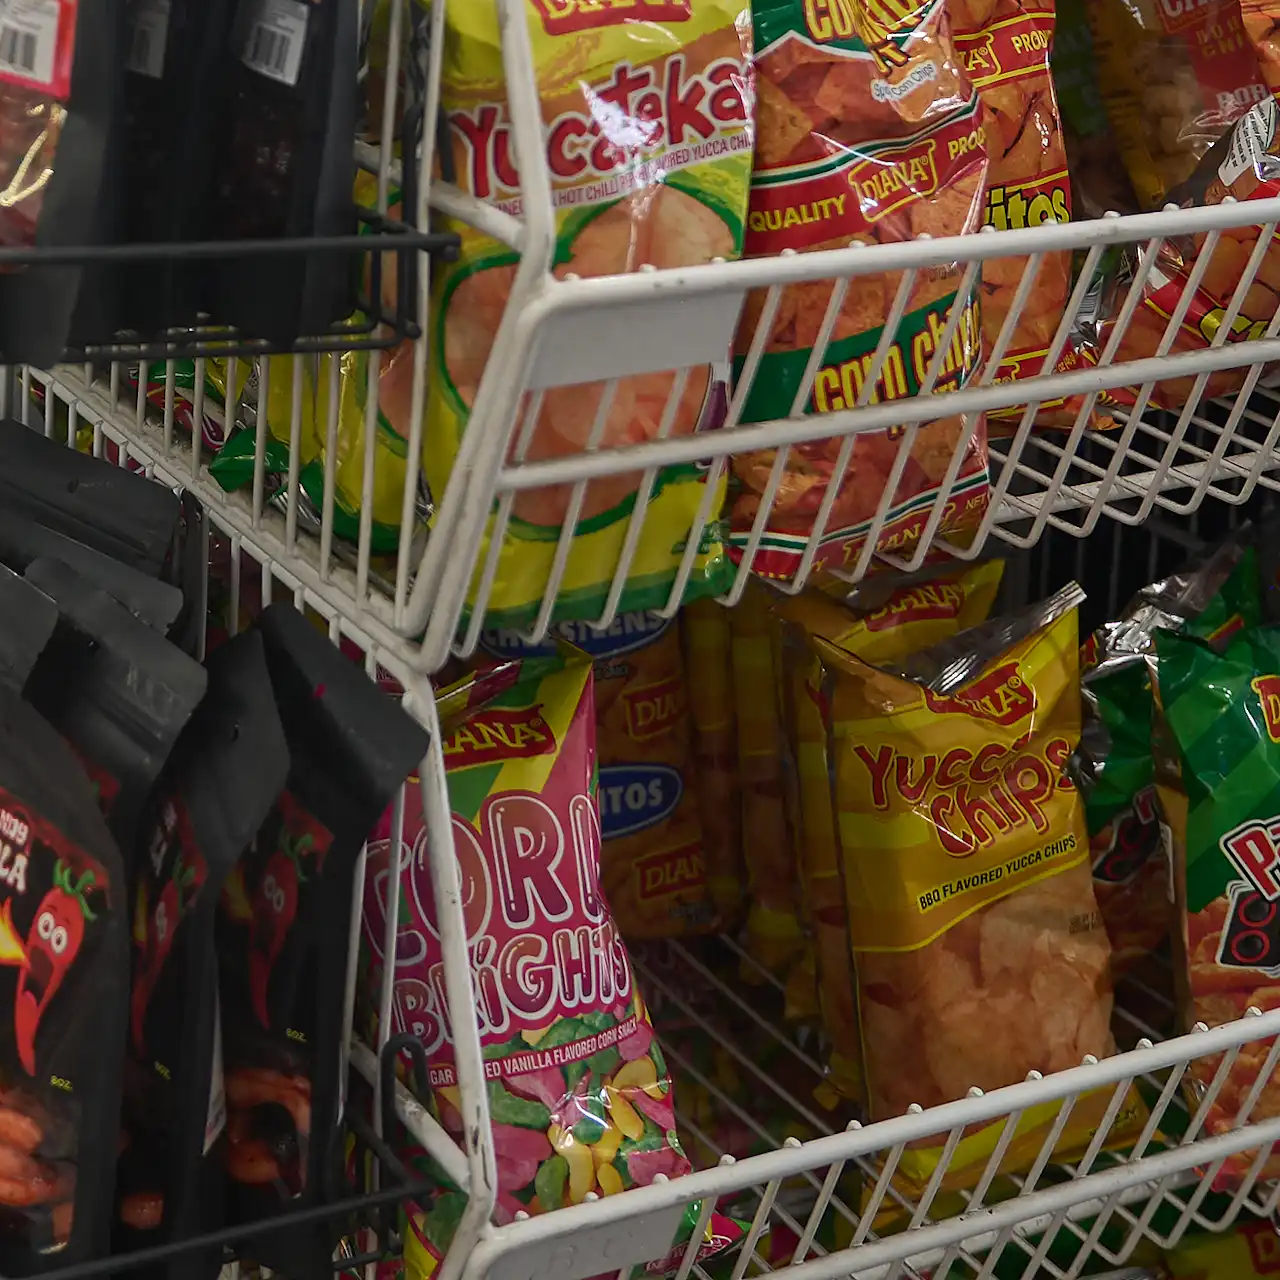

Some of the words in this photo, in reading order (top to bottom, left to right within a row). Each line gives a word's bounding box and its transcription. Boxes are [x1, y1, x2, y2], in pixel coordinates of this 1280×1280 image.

[558, 187, 582, 206] HOT
[692, 137, 728, 161] YUCCA
[751, 195, 846, 232] QUALITY
[862, 159, 928, 205] DIANA
[919, 885, 942, 910] BBQ
[942, 866, 1004, 901] FLAVORED
[1004, 851, 1043, 883] YUCCA
[1043, 834, 1077, 864] CHIPS
[502, 1051, 553, 1074] VANILLA
[554, 1036, 598, 1068] FLAVORED
[597, 1031, 619, 1052] CORN
[617, 1023, 637, 1045] SNACK
